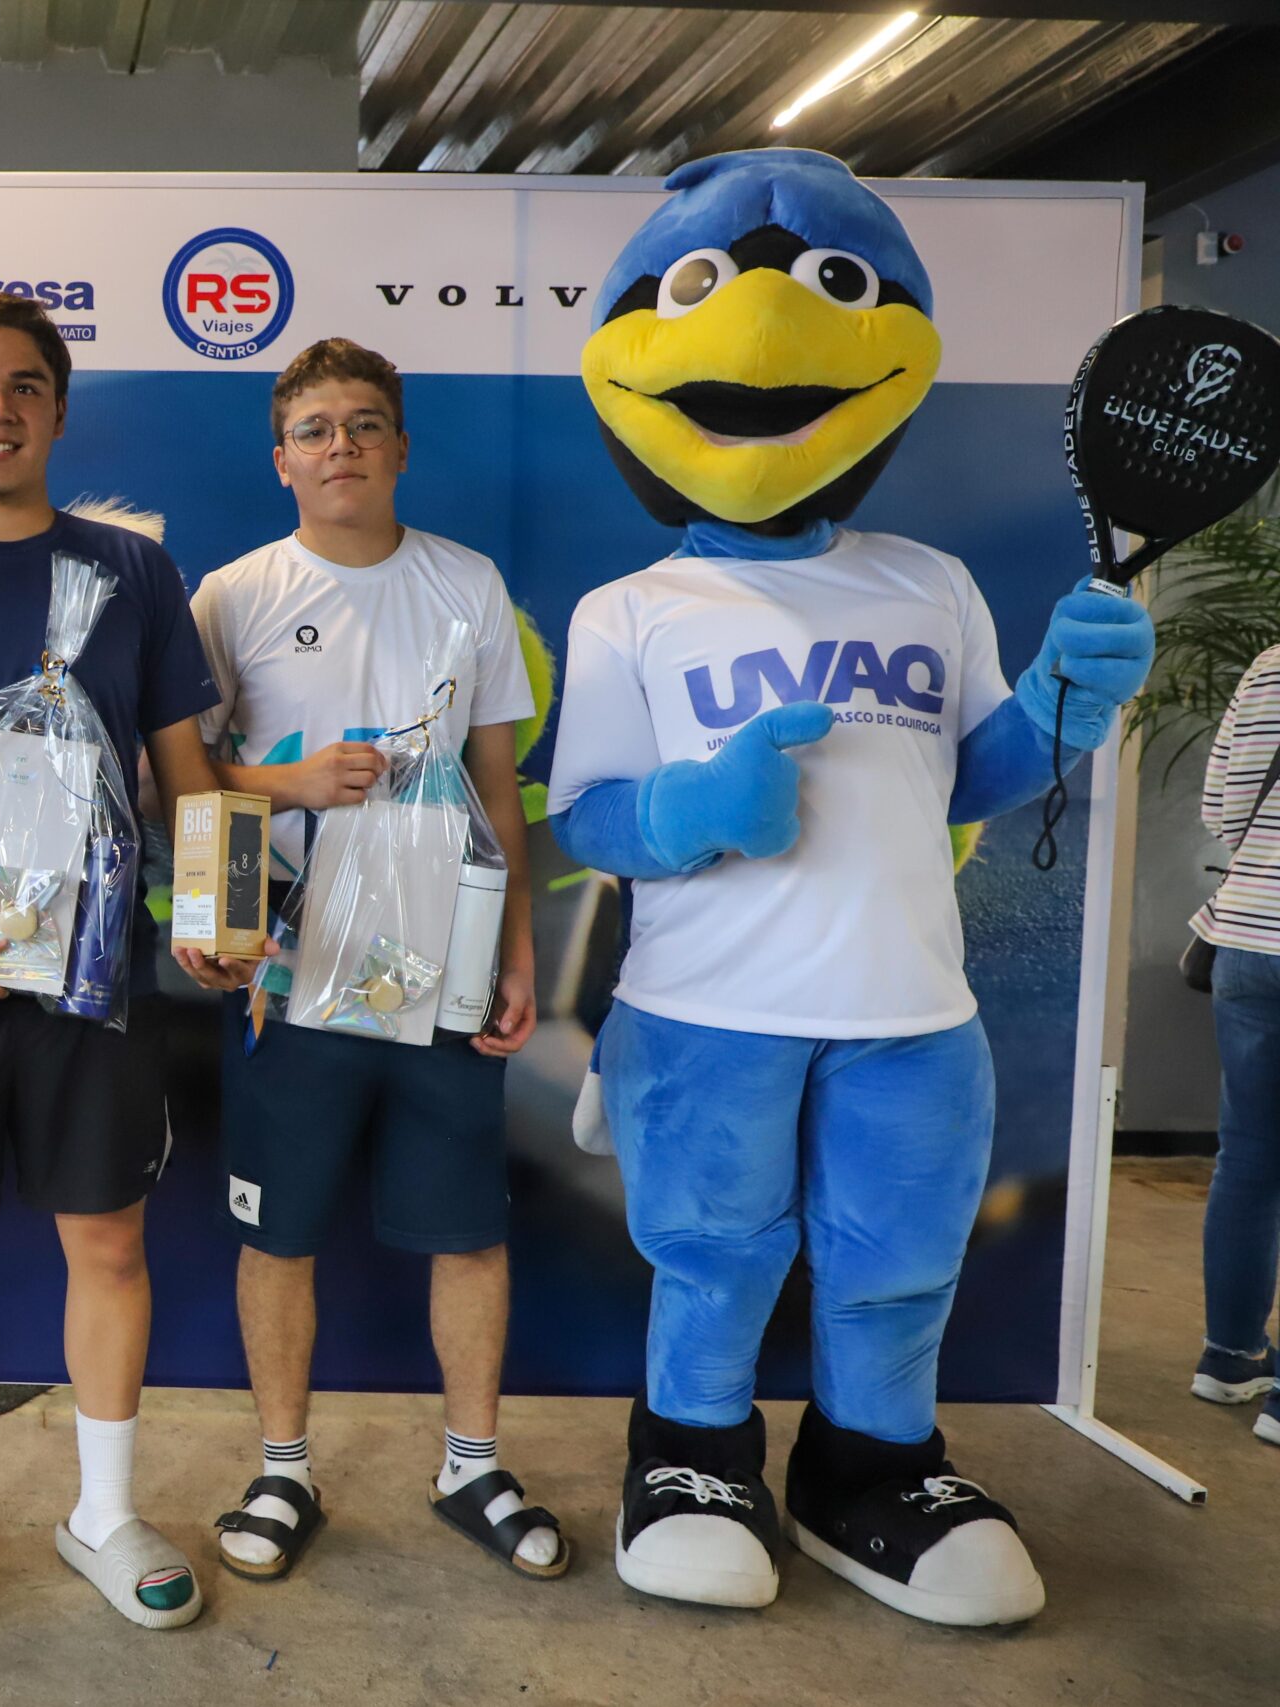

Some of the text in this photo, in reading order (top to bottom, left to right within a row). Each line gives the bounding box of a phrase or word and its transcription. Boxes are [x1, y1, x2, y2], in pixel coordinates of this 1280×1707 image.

[187, 274, 271, 313] RS
[376, 285, 587, 307] VOLV
[58, 327, 92, 340] MATO
[202, 320, 254, 335] Viajes
[196, 341, 258, 358] CENTRO
[1104, 395, 1174, 433] BLUE
[1064, 400, 1084, 488] PADEL
[1152, 438, 1197, 462] CLUB
[1077, 494, 1101, 564] BLUE
[684, 640, 946, 729] UVAQ
[832, 712, 942, 736] ASCO DE QUIROGA
[183, 807, 213, 835] BIG
